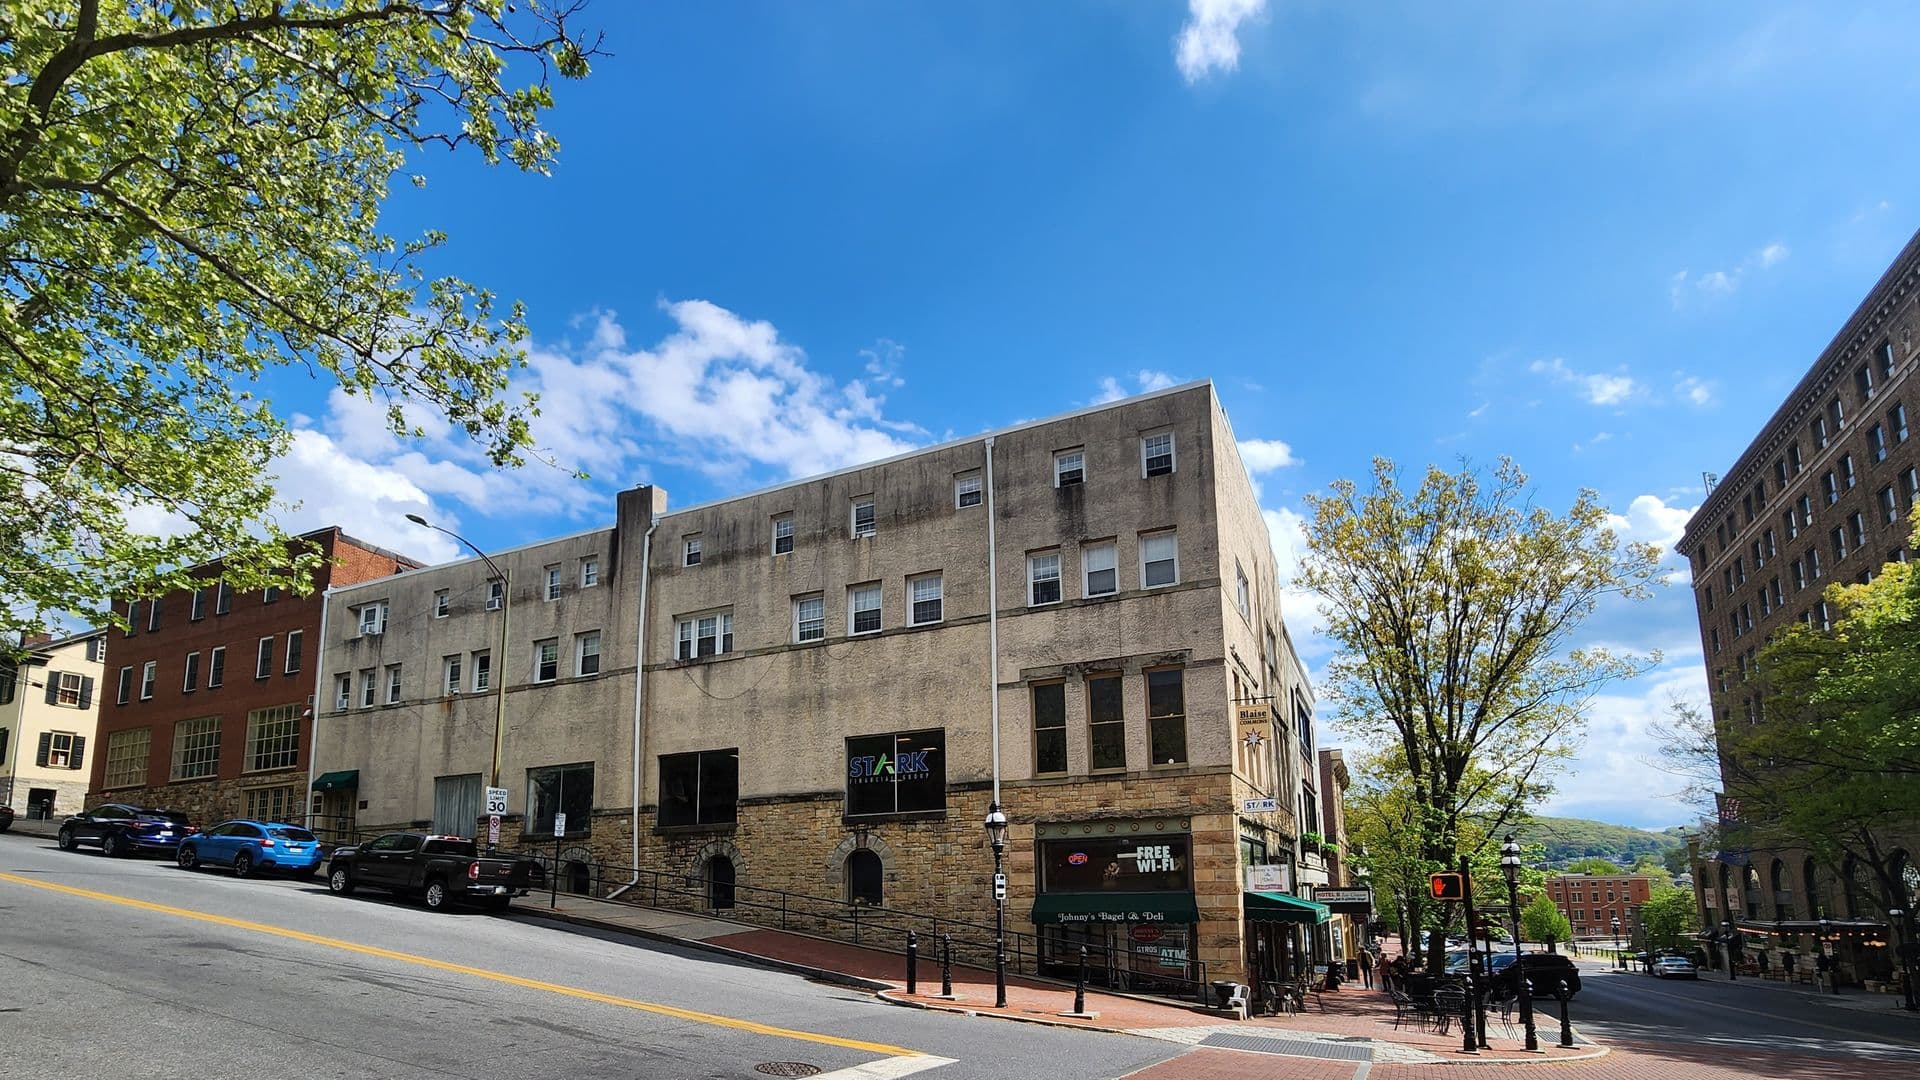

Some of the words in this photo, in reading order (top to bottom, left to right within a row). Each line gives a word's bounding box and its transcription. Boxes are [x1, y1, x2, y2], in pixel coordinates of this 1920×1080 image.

[1240, 710, 1267, 719] Blaise
[849, 751, 929, 778] STARK
[488, 801, 506, 813] 30
[1068, 854, 1088, 864] OPEN
[1136, 845, 1171, 860] FREE
[1136, 857, 1175, 873] WI-FI
[1057, 912, 1096, 923] Johnny's
[1098, 912, 1125, 921] Bagel
[1127, 912, 1140, 921] &
[1142, 912, 1164, 921] Deli
[1160, 948, 1187, 962] ATM
